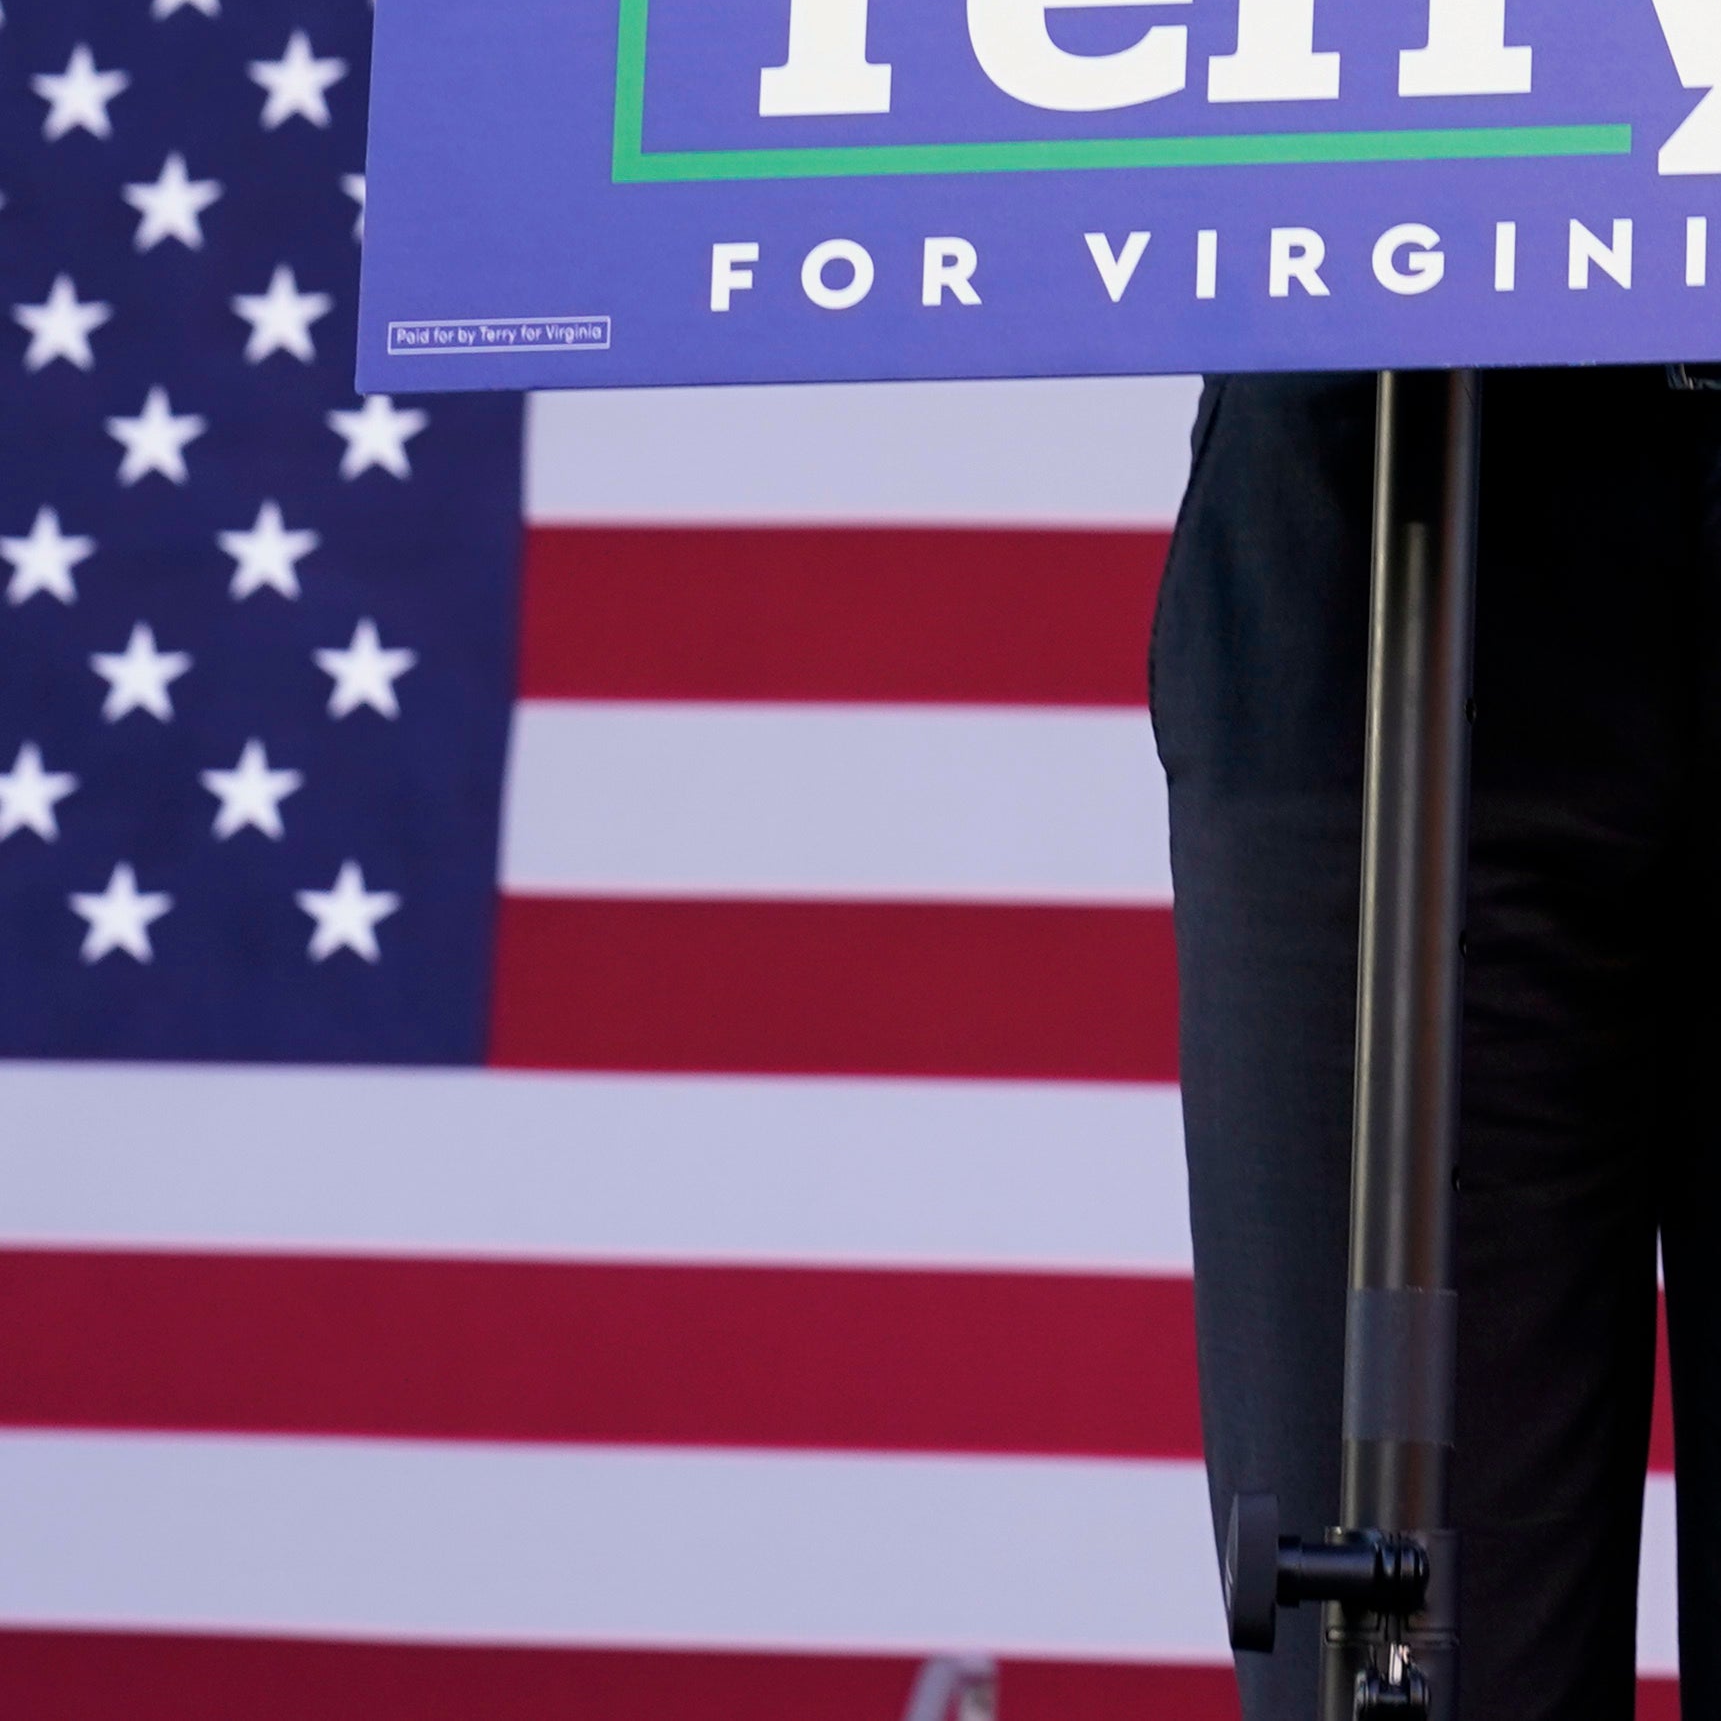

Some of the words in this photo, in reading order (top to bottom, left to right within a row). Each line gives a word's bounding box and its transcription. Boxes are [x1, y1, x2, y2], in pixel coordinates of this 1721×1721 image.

[710, 235, 983, 313] FOR
[397, 328, 430, 345] Paid
[433, 327, 454, 343] for
[457, 326, 477, 346] by
[480, 326, 517, 345] Terry
[520, 325, 542, 342] for
[545, 323, 602, 345] Virginia
